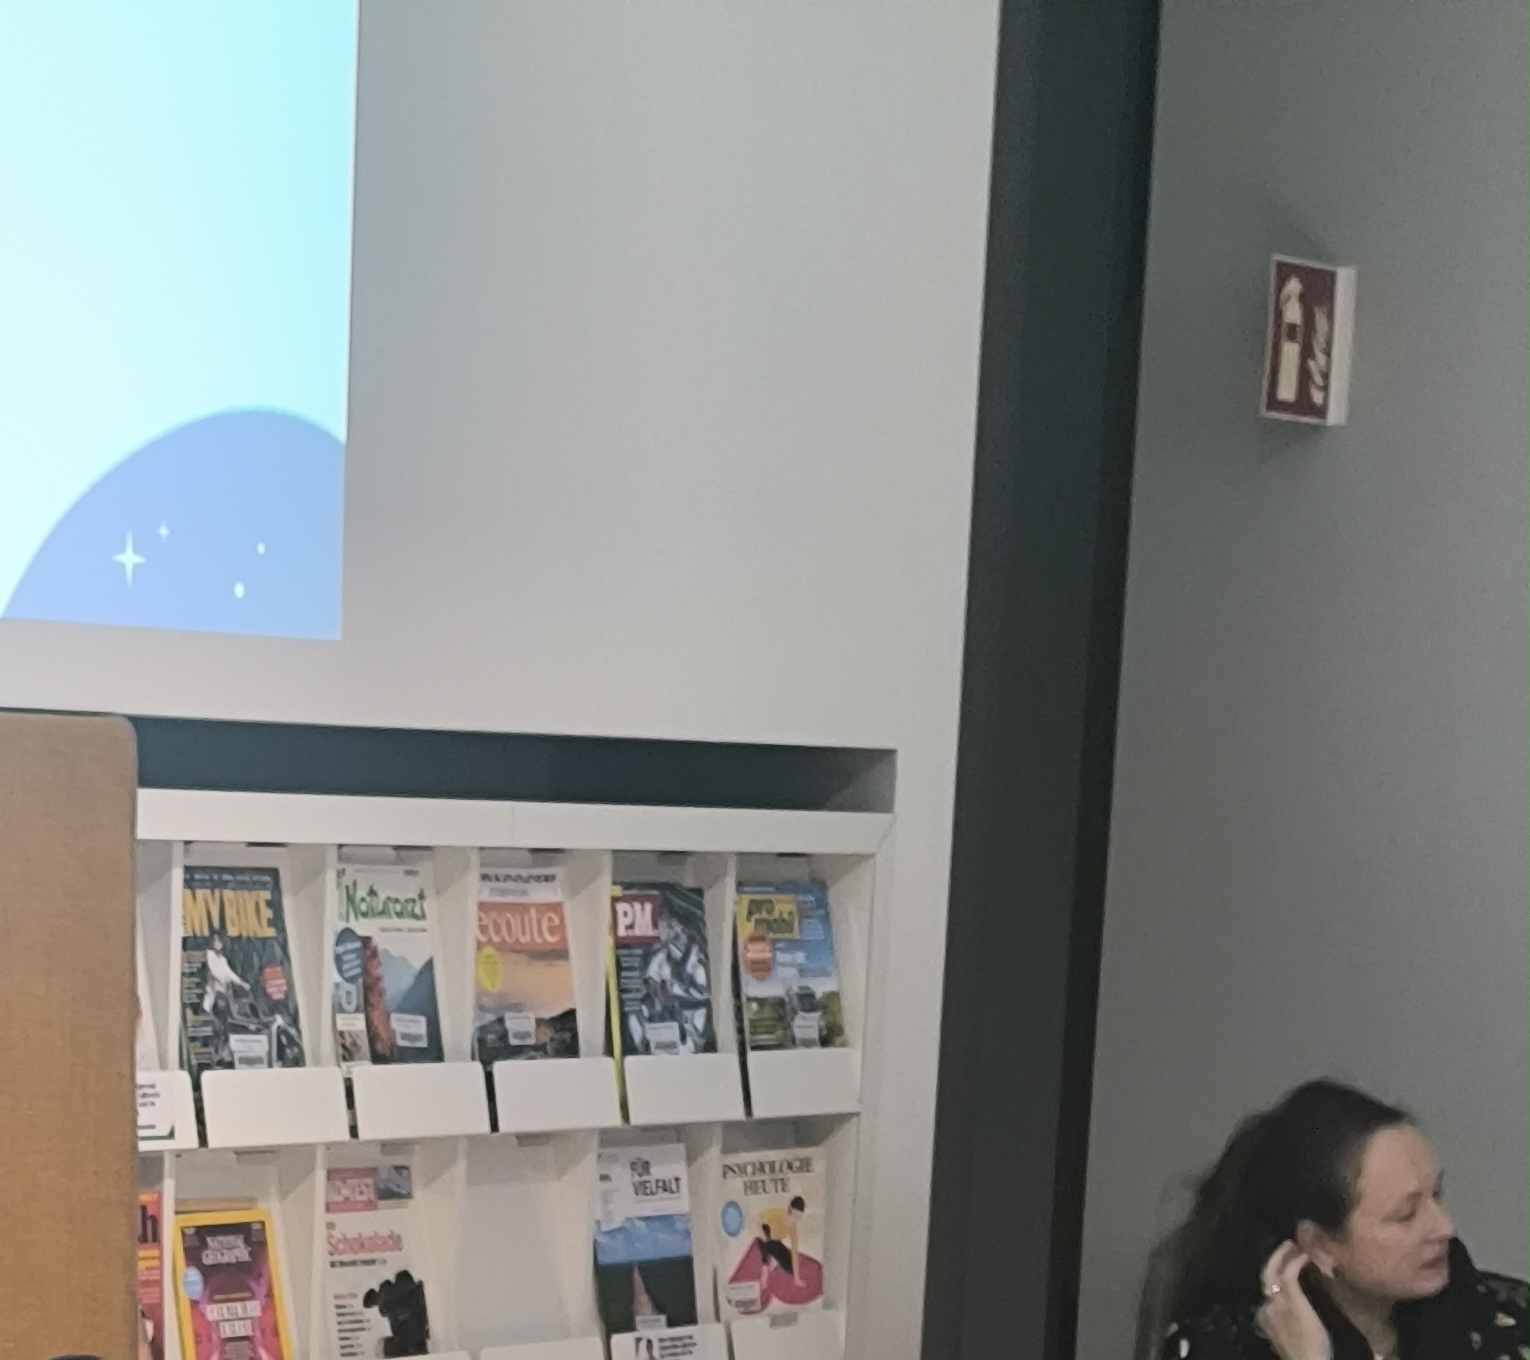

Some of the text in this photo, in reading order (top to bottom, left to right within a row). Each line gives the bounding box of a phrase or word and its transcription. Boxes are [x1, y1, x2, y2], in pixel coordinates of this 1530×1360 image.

[223, 888, 276, 937] BIKE
[722, 1157, 814, 1180] PSYCHOLOGIE
[632, 1176, 681, 1197] VIELFALT
[743, 1177, 791, 1196] HEUTE
